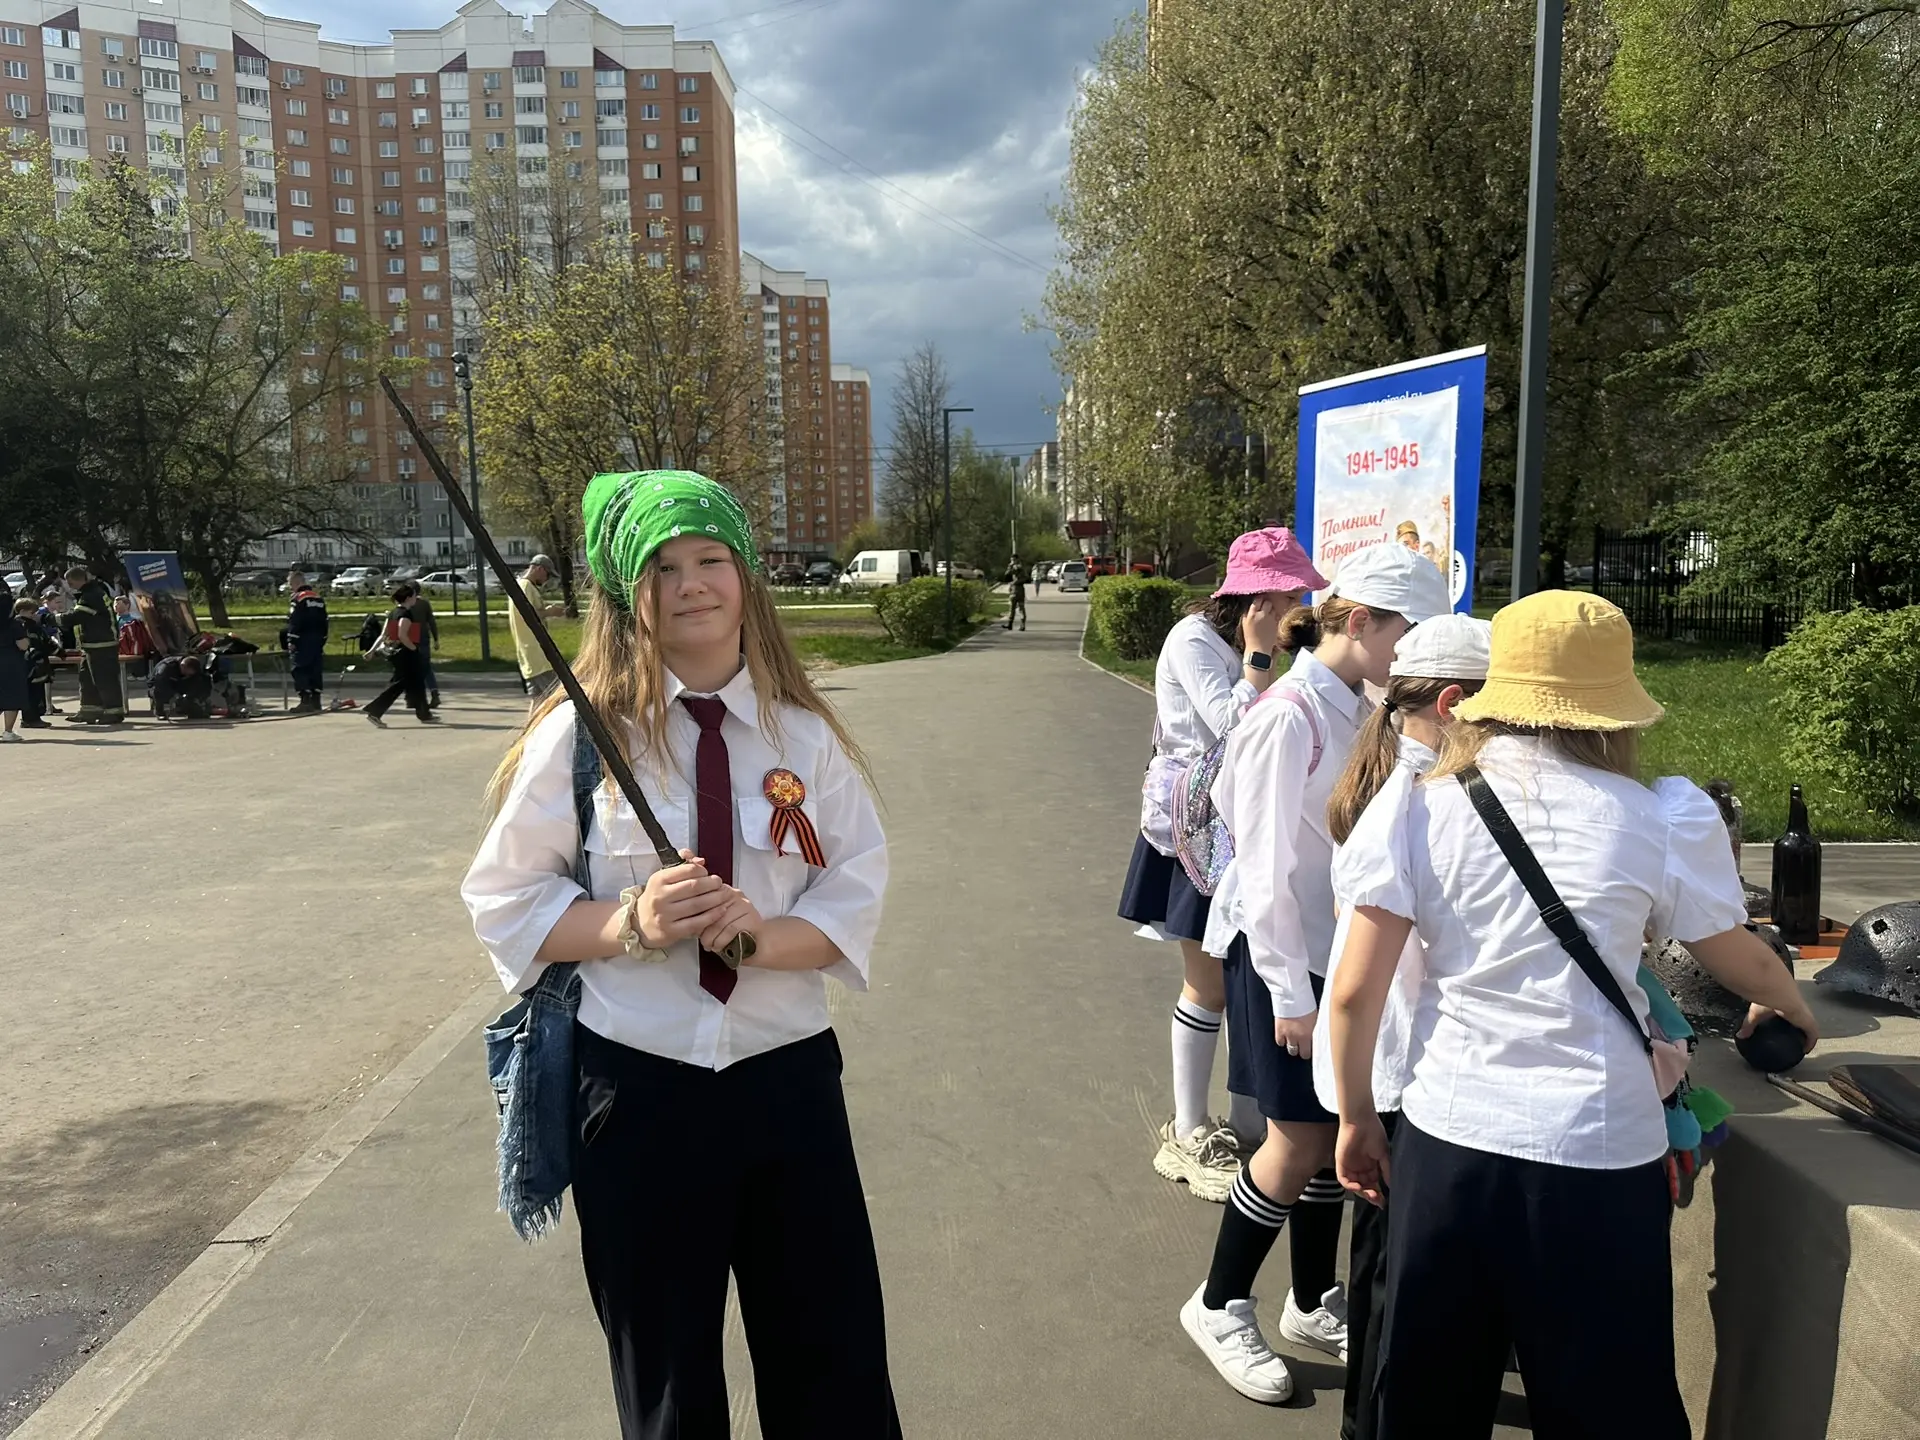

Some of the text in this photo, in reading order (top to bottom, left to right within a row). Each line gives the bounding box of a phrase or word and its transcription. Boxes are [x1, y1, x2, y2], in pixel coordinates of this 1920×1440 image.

[1346, 442, 1419, 476] 1941-1945
[1321, 507, 1386, 540] Помним!
[1320, 532, 1388, 564] Гордим!
